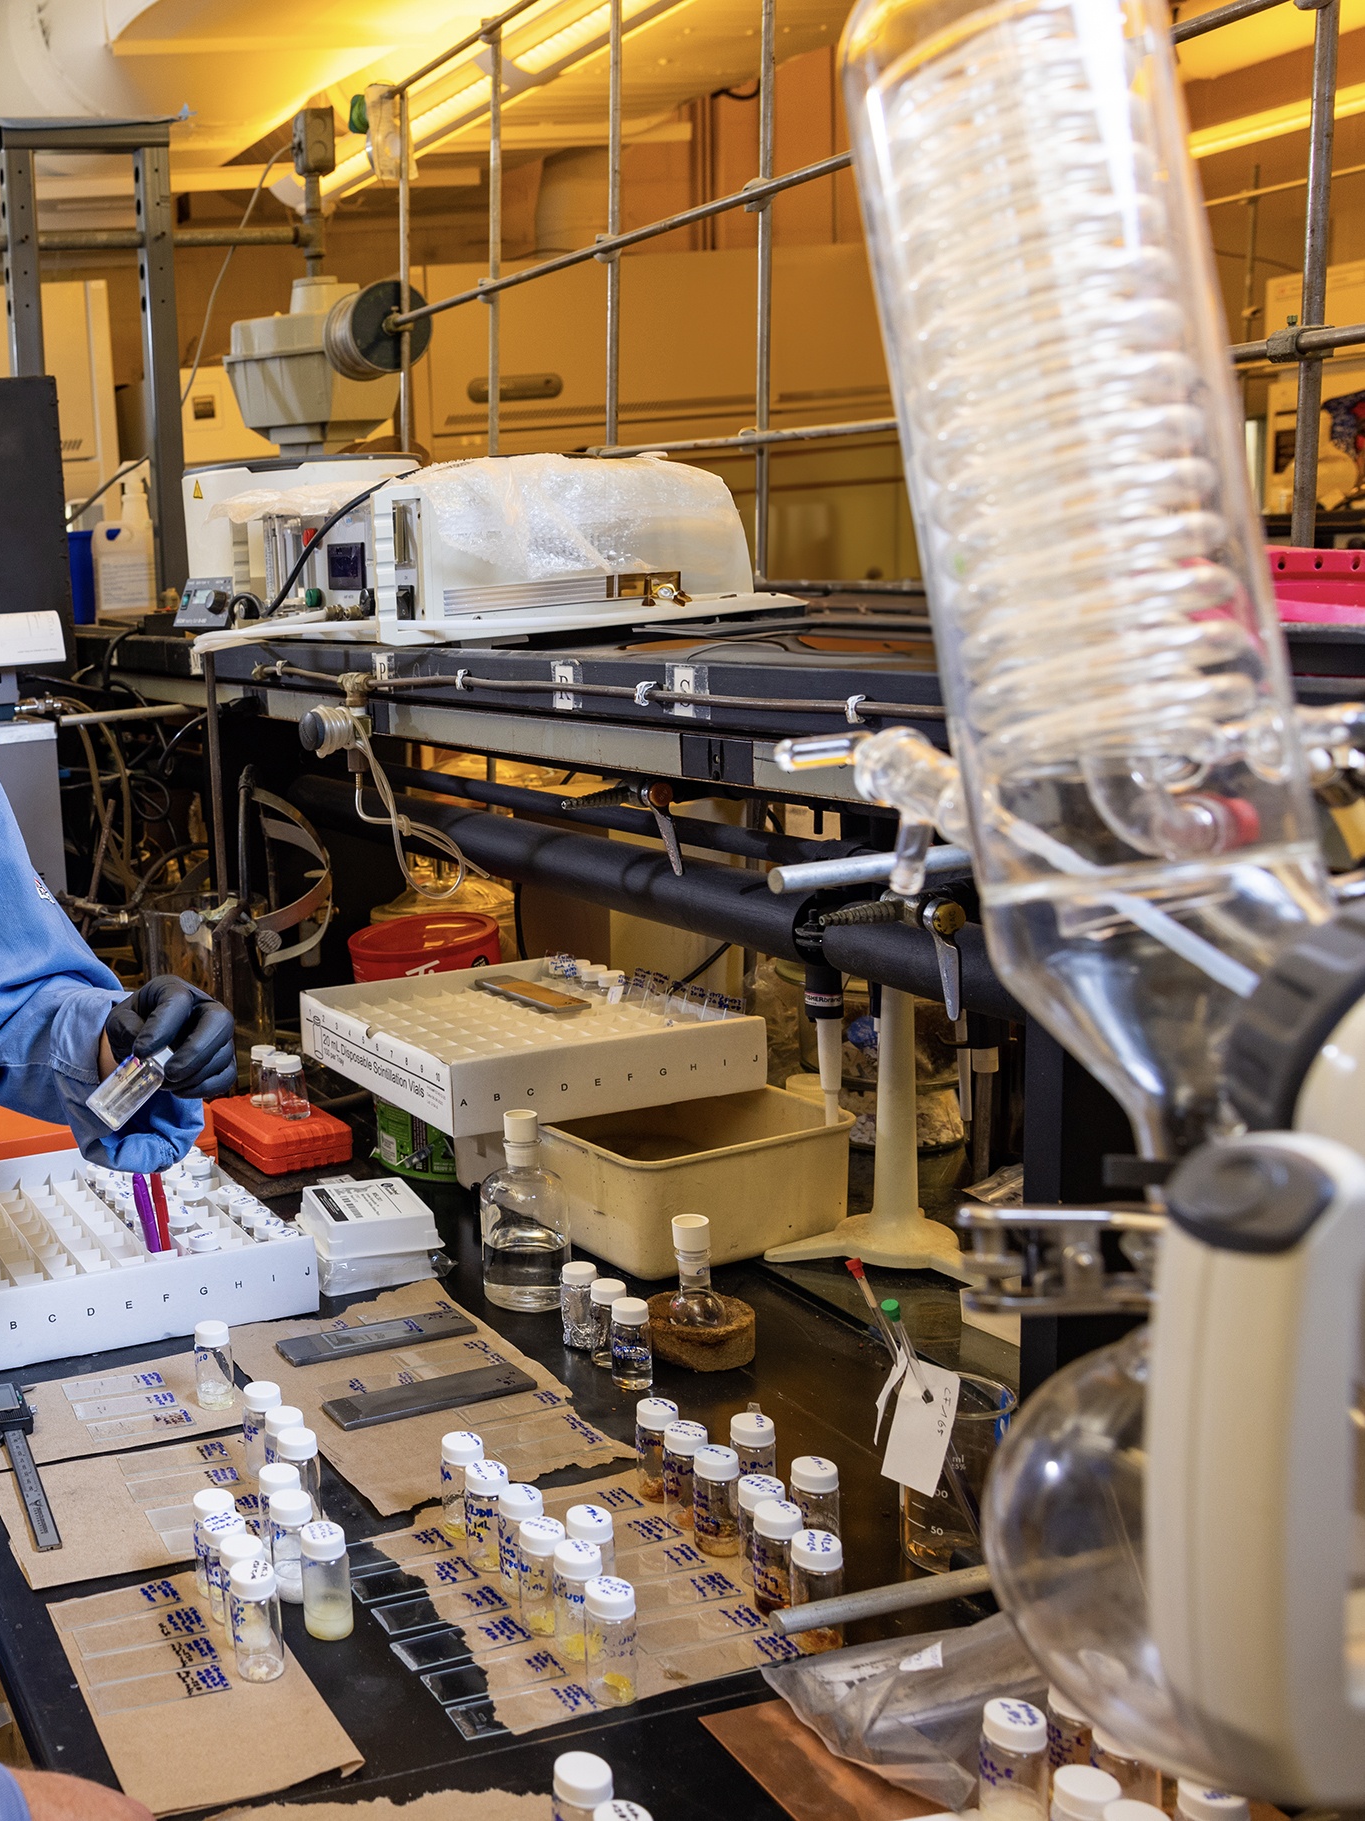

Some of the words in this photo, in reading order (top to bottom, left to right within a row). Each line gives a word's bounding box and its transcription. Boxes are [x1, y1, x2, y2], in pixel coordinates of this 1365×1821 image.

[558, 675, 570, 700] R
[679, 679, 691, 707] S
[322, 1033, 331, 1047] 20
[331, 1040, 340, 1053] mL
[340, 1043, 373, 1071] Disposable
[372, 1061, 408, 1090] Scintillation
[407, 1078, 425, 1098] Vials
[336, 1054, 345, 1067] Tray
[459, 1098, 468, 1107] A
[493, 1092, 501, 1102] B
[526, 1087, 535, 1097] C
[560, 1082, 569, 1092] D
[594, 1077, 602, 1087] E
[627, 1072, 634, 1082] F
[659, 1067, 668, 1077] G
[689, 1063, 698, 1072] H
[752, 1054, 759, 1063] J
[9, 1320, 18, 1331] B
[47, 1313, 57, 1323] C
[86, 1307, 96, 1317] D
[125, 1300, 134, 1310] E
[162, 1293, 170, 1303] F
[199, 1286, 209, 1296] G
[234, 1280, 243, 1289] H
[304, 1266, 311, 1277] J
[952, 1454, 965, 1463] ml
[934, 1488, 949, 1499] 00
[930, 1525, 944, 1536] 50
